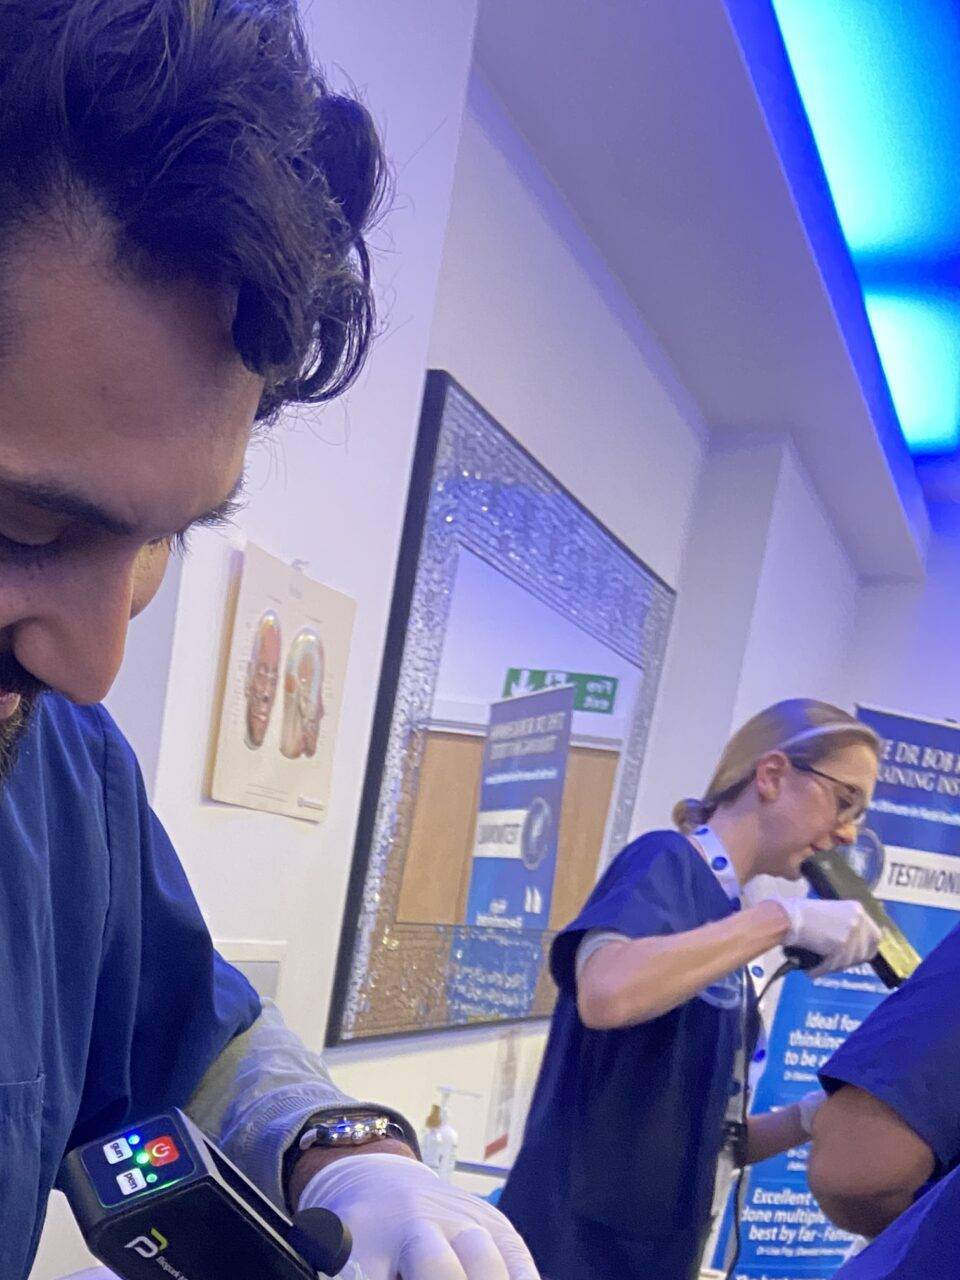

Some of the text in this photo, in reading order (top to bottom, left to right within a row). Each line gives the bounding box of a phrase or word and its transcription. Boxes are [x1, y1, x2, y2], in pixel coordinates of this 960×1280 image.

[895, 741, 920, 766] DR
[921, 746, 954, 772] BOB
[784, 1050, 799, 1066] to
[800, 1049, 818, 1067] be
[110, 1142, 124, 1159] gun
[123, 1172, 138, 1190] pen
[752, 1186, 811, 1206] Excellent
[748, 1224, 778, 1241] best
[778, 1224, 796, 1244] by
